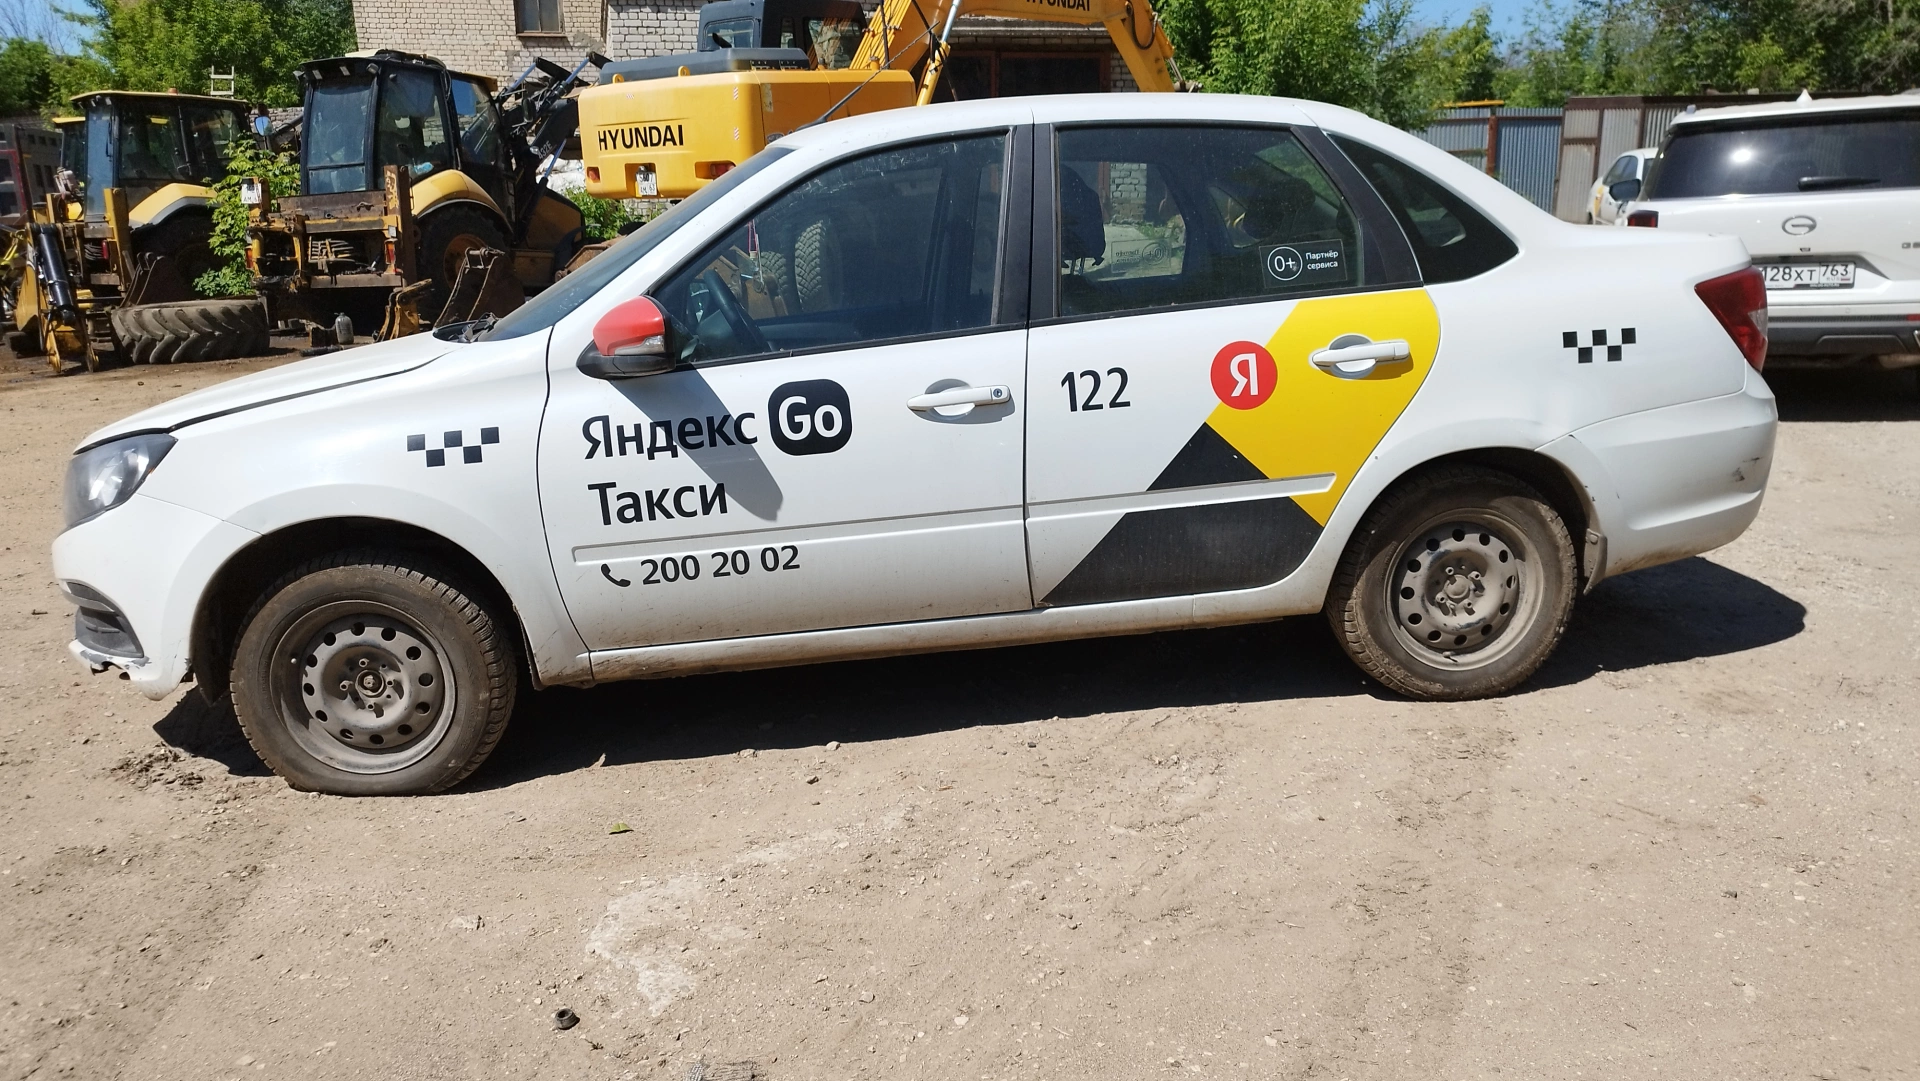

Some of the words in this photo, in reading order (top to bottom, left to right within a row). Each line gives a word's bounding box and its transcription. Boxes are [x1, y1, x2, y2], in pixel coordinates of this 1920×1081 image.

[1026, 0, 1090, 11] NDAI
[598, 124, 684, 151] HYUNDAI
[1274, 255, 1296, 272] 0+
[1305, 250, 1339, 260] Партнёр
[1307, 261, 1339, 270] сервиса
[1762, 265, 1816, 281] 128ХТ
[1821, 264, 1849, 277] 763
[1229, 352, 1259, 397] Я
[1060, 366, 1131, 413] 122
[582, 412, 758, 461] Яндекс
[778, 395, 843, 441] Go
[587, 481, 728, 526] Такси
[640, 554, 701, 586] 200
[711, 549, 750, 578] 20
[760, 544, 800, 572] 02
